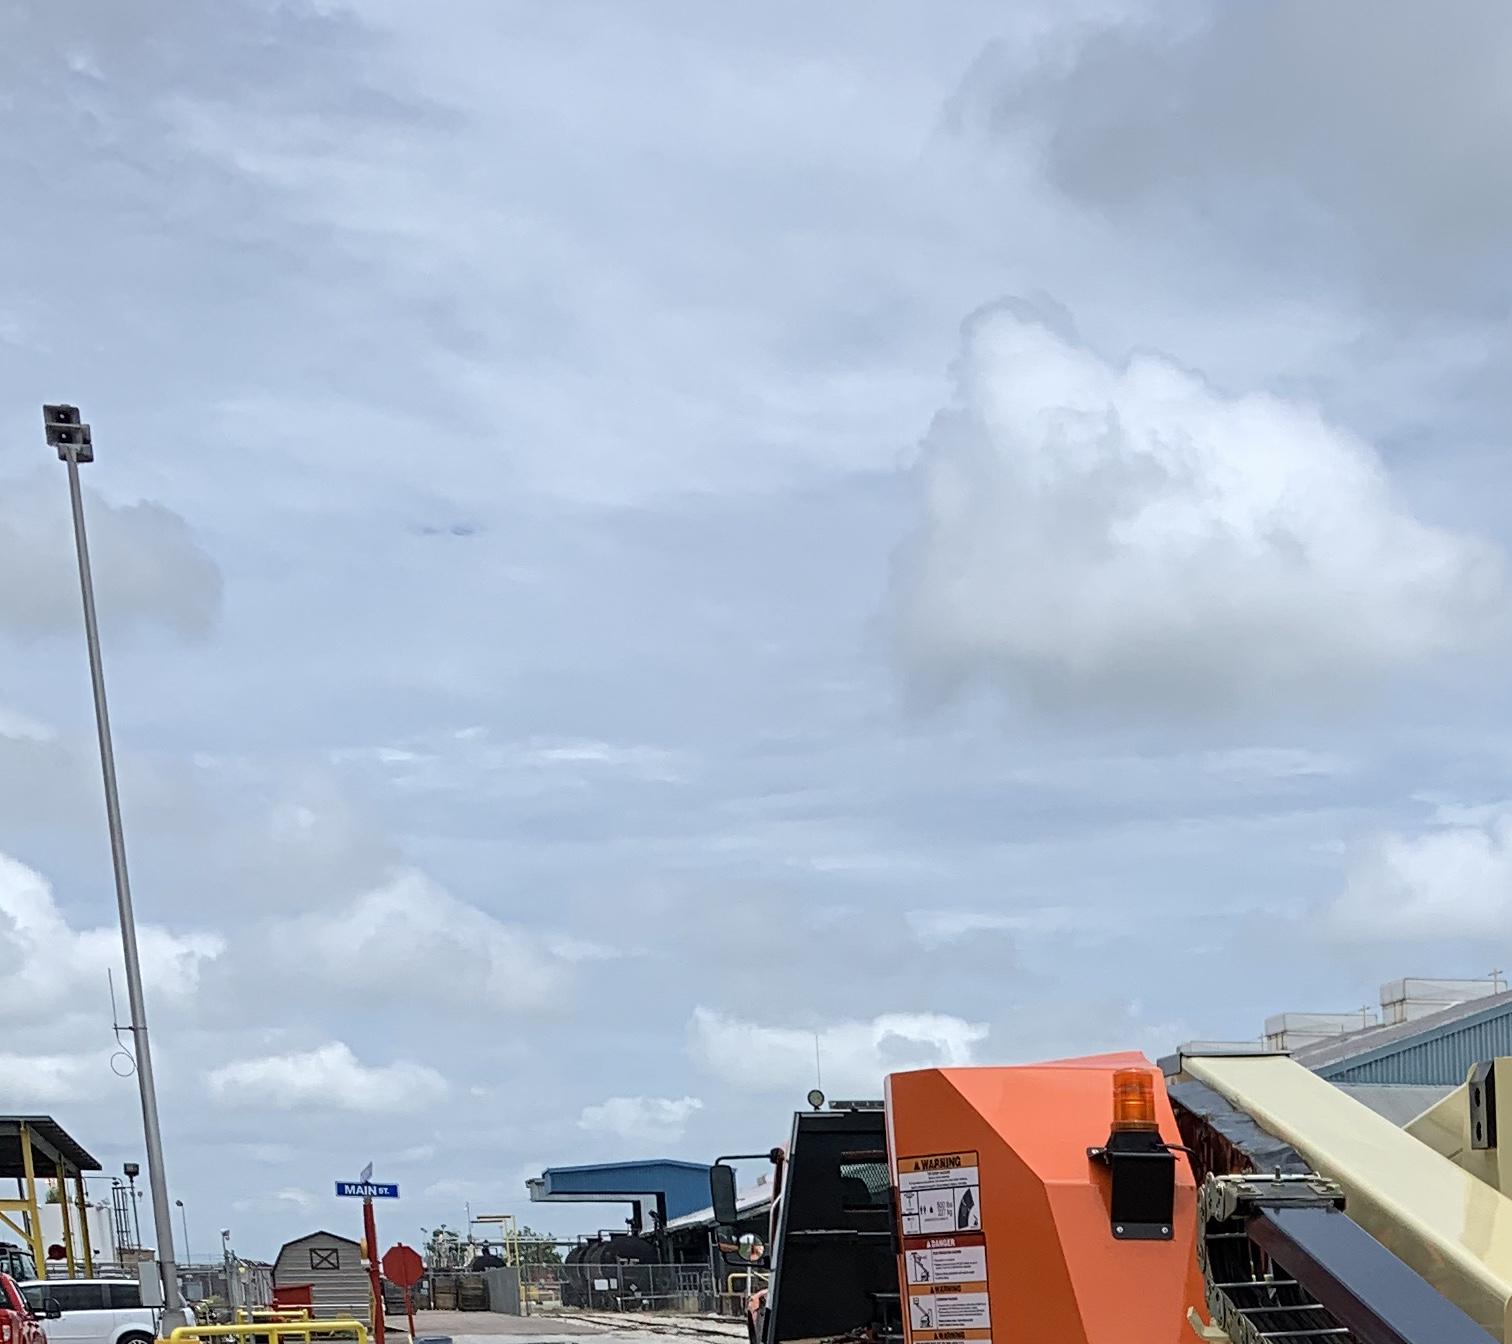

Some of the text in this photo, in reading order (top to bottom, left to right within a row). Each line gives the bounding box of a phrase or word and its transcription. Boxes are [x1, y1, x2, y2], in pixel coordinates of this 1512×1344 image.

[920, 1156, 961, 1171] WARNING
[344, 1184, 377, 1196] MAIN
[931, 1238, 956, 1248] DANGER
[934, 1285, 962, 1293] WARNING
[938, 1331, 965, 1340] WARNING
